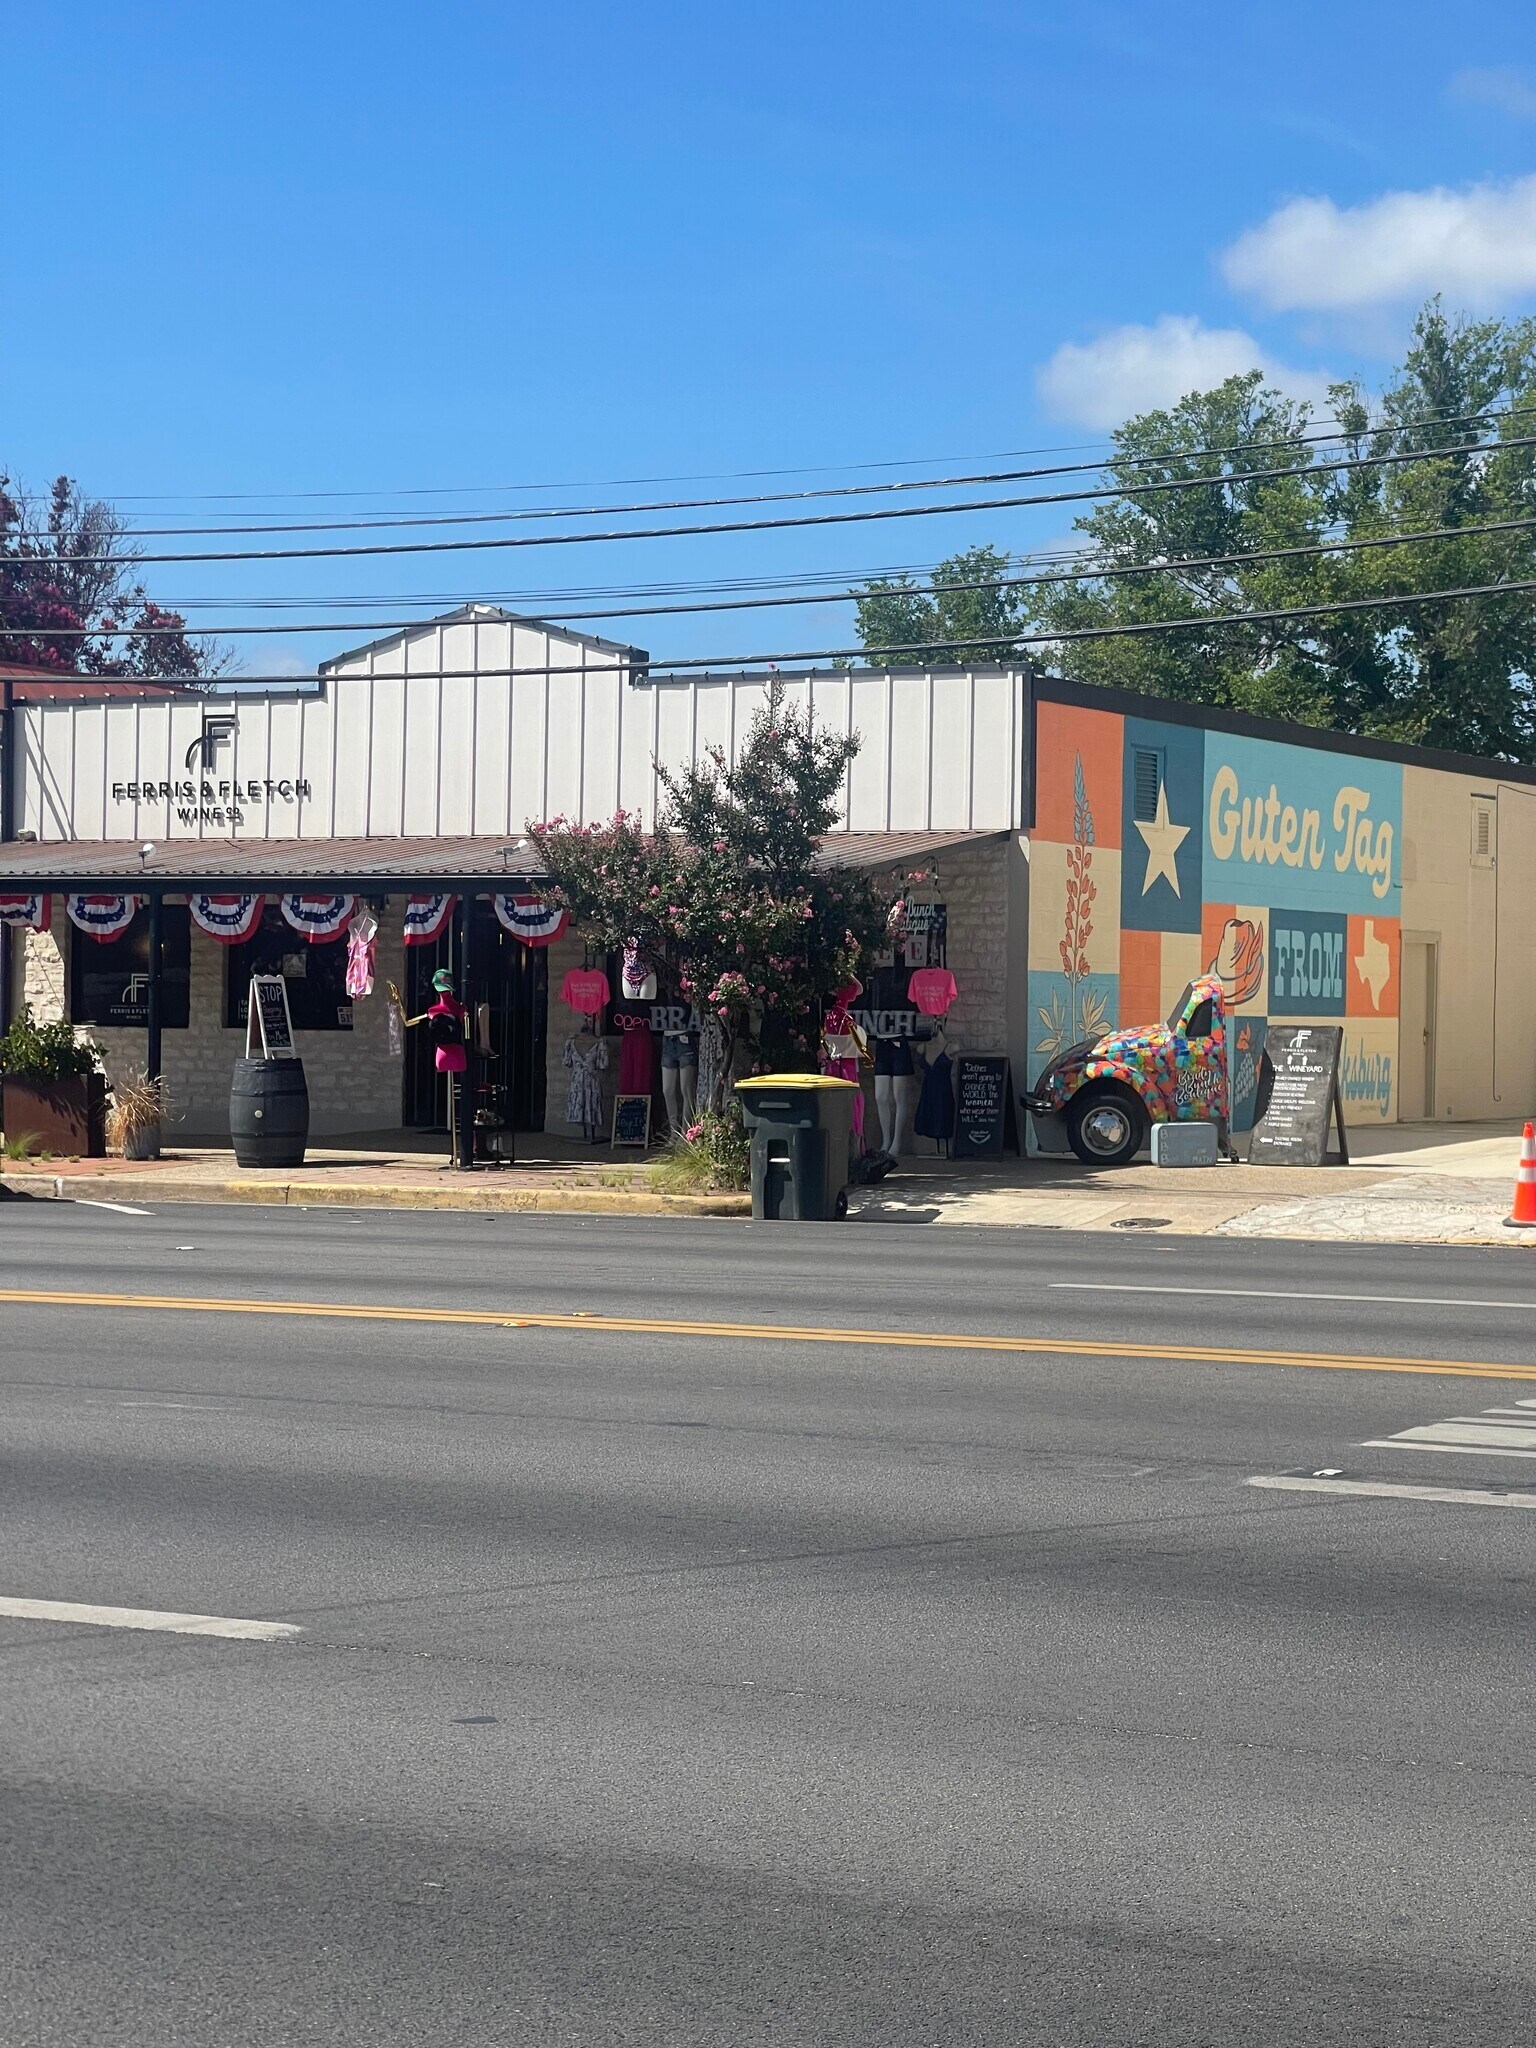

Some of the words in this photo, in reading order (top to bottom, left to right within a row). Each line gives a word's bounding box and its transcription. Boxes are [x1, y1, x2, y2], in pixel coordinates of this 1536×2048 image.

[112, 781, 193, 799] FERRIS
[200, 780, 210, 797] &
[219, 779, 309, 797] FLETCH
[177, 807, 222, 820] WINE
[1209, 765, 1326, 870] Guten
[1333, 786, 1394, 899] Tag
[1274, 929, 1344, 998] FROM
[259, 985, 282, 1003] STOP
[613, 1013, 650, 1031] open
[1288, 1065, 1323, 1073] WINEYARD
